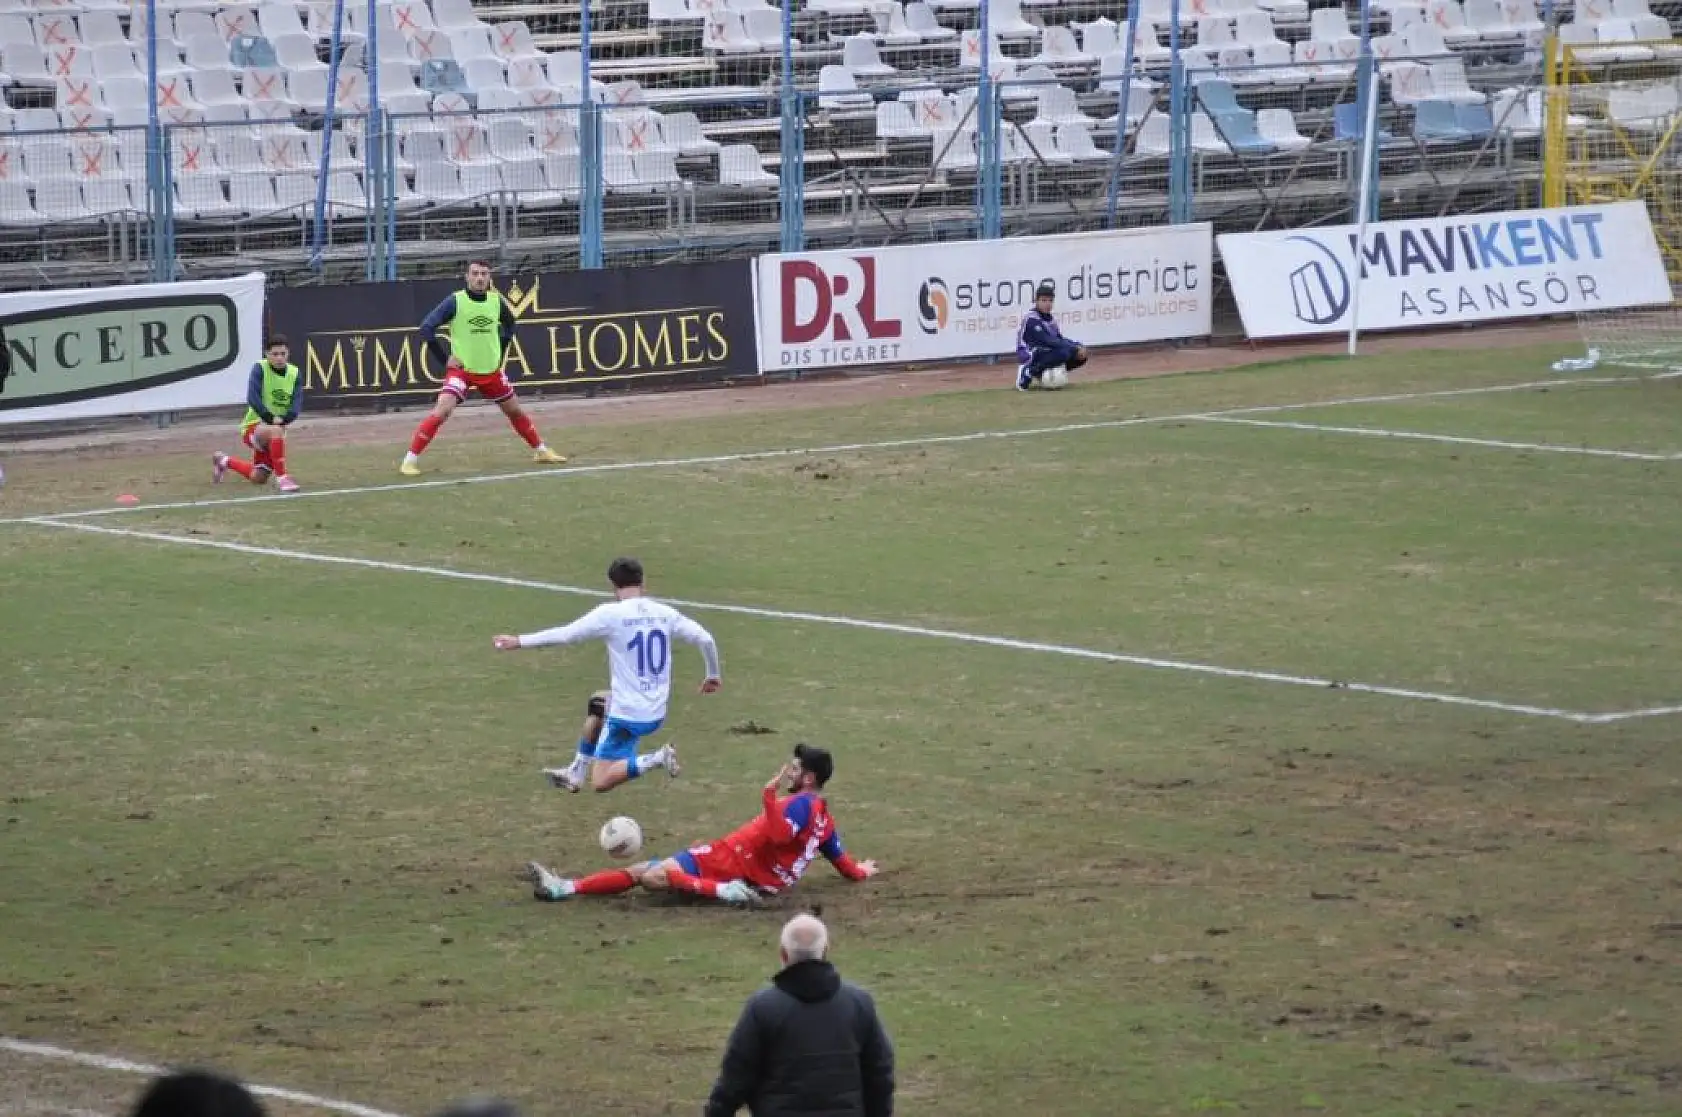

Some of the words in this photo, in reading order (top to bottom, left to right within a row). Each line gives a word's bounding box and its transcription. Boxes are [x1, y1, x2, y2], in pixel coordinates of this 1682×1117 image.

[781, 257, 902, 344] DRL
[1067, 258, 1198, 301] district
[1400, 271, 1600, 317] ASANSÖR
[1086, 299, 1197, 321] distributors
[547, 312, 729, 374] HOMES
[626, 629, 667, 677] 10
